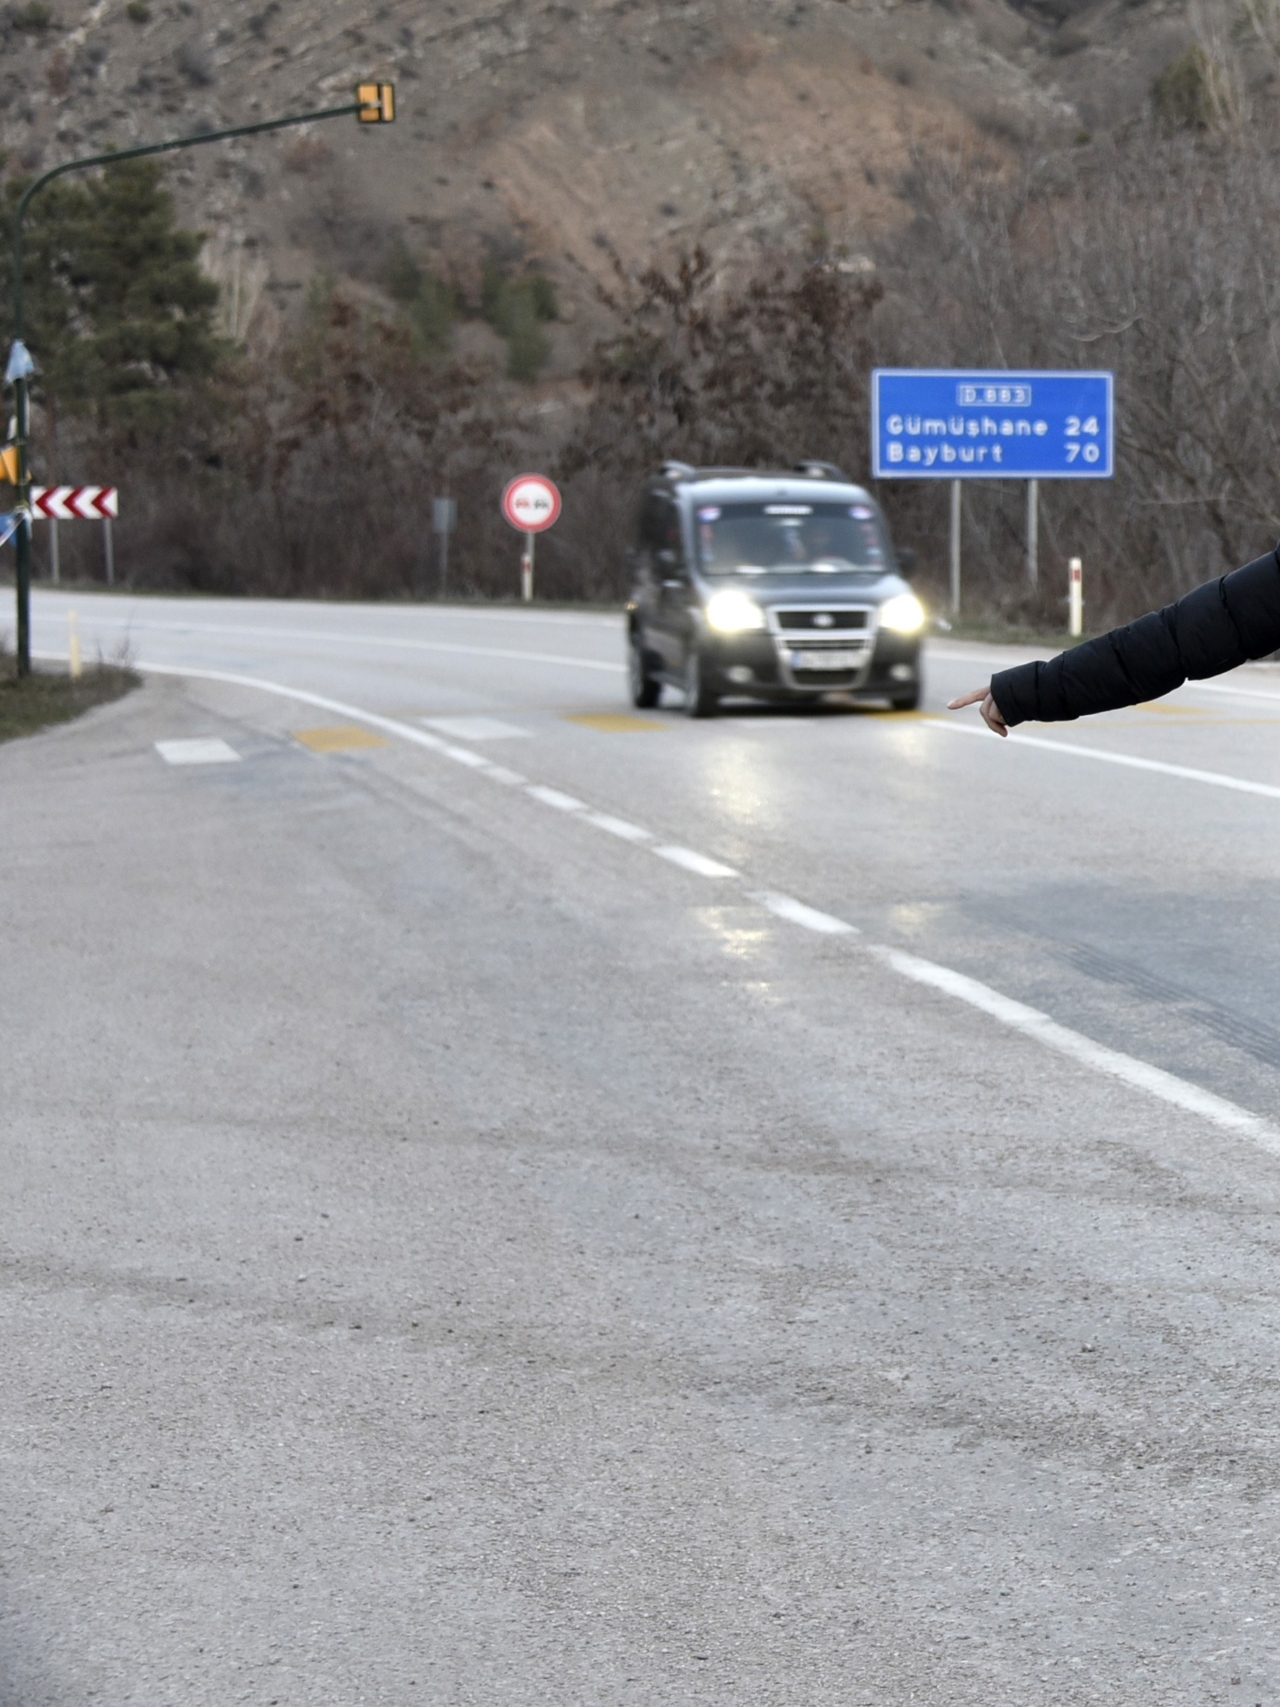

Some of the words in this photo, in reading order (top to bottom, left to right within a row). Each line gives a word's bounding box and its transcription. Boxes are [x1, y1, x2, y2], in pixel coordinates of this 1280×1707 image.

[886, 414, 1048, 437] Gümüşhane
[1064, 415, 1099, 436] 24
[886, 441, 1003, 466] Bayburt
[1064, 442, 1100, 463] 70
